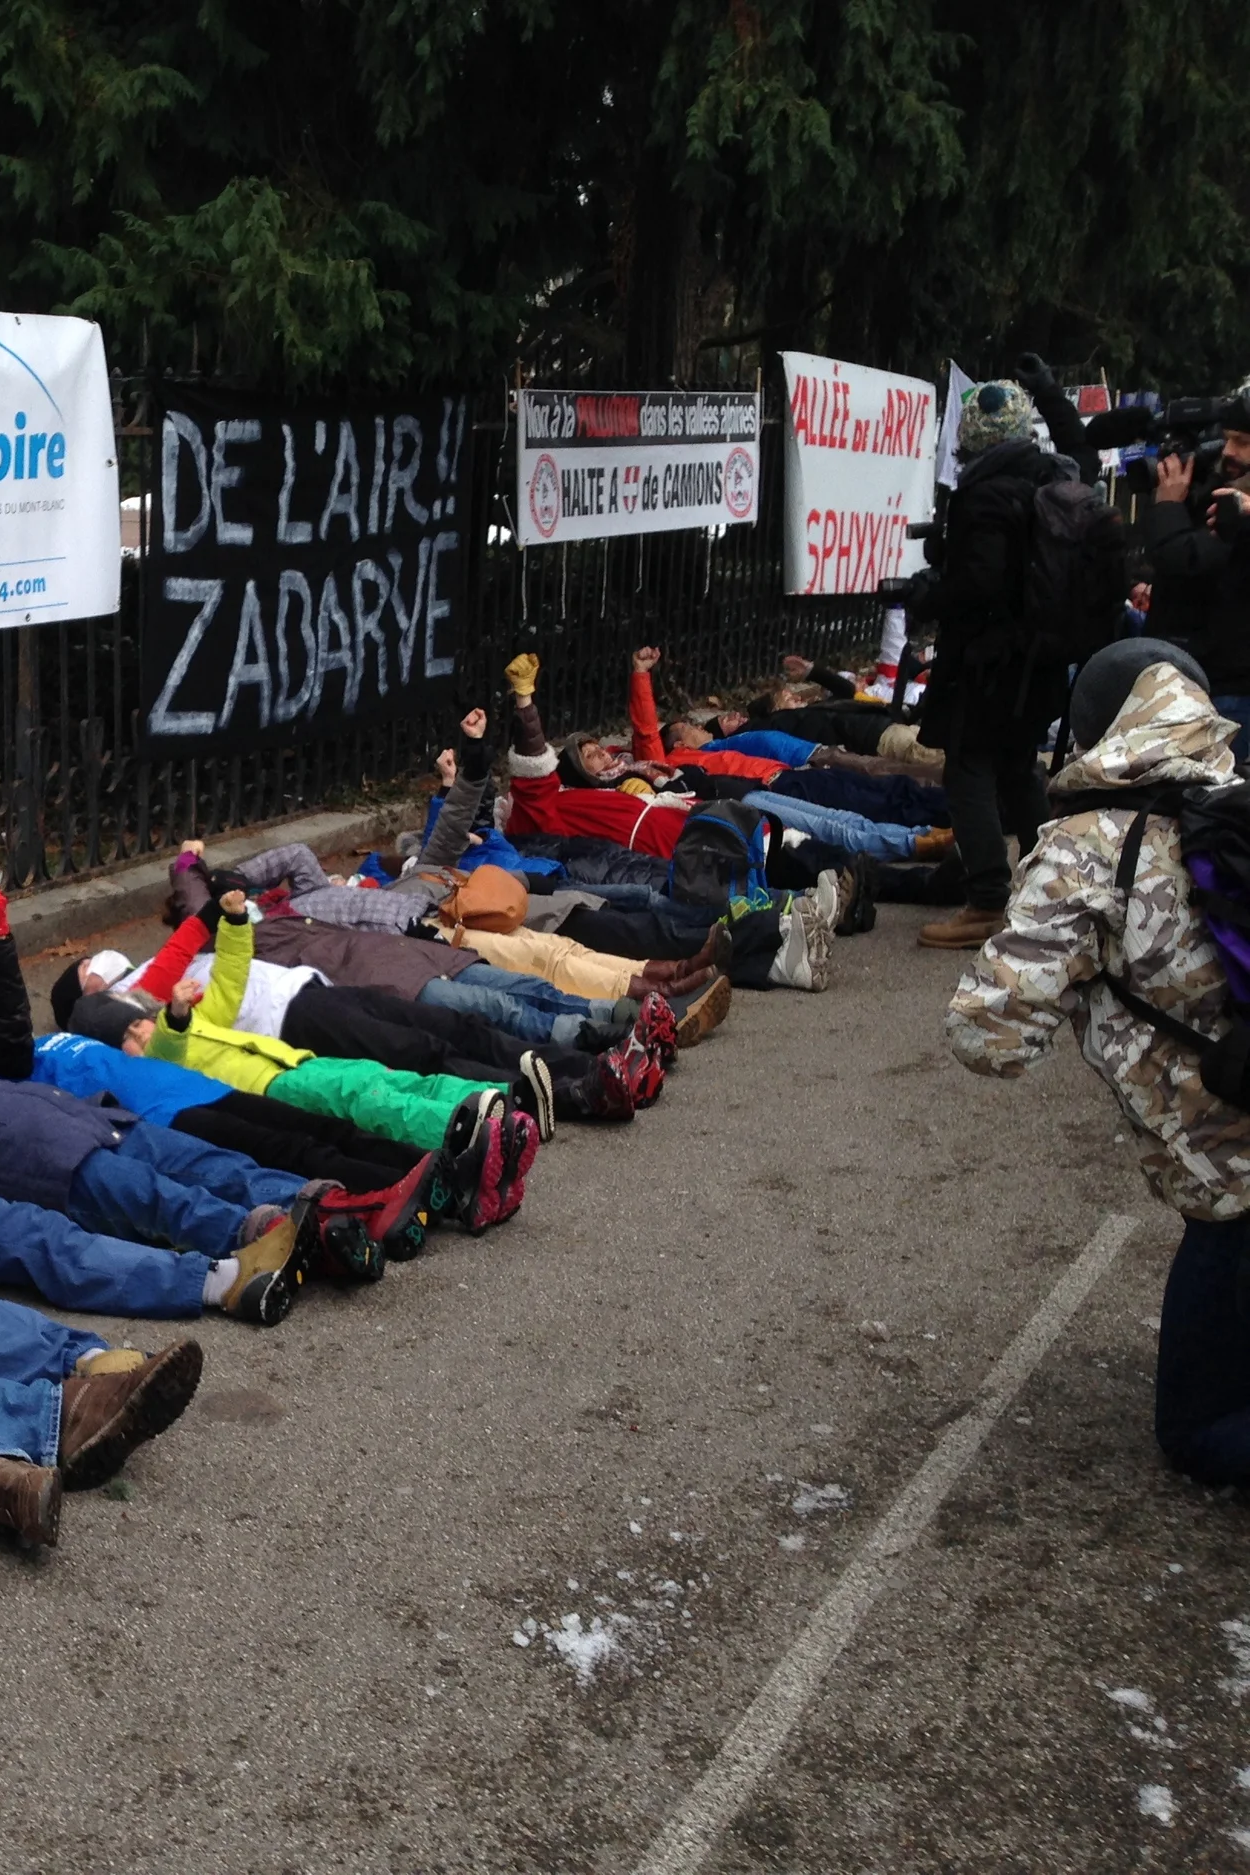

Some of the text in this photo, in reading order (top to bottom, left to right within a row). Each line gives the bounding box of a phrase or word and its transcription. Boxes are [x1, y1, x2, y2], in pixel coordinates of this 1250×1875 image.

[525, 394, 550, 439] Non
[550, 394, 562, 439] à
[561, 395, 576, 438] la
[640, 393, 667, 437] dans
[668, 396, 684, 437] les
[684, 395, 720, 436] vallées
[719, 397, 756, 443] alpines
[5, 502, 17, 515] DU
[18, 499, 66, 513] MONT-BLANC
[161, 410, 262, 553] DE
[561, 467, 605, 518] HALTE
[609, 466, 618, 514] A
[642, 465, 658, 511] de
[662, 460, 723, 510] CAMIONS
